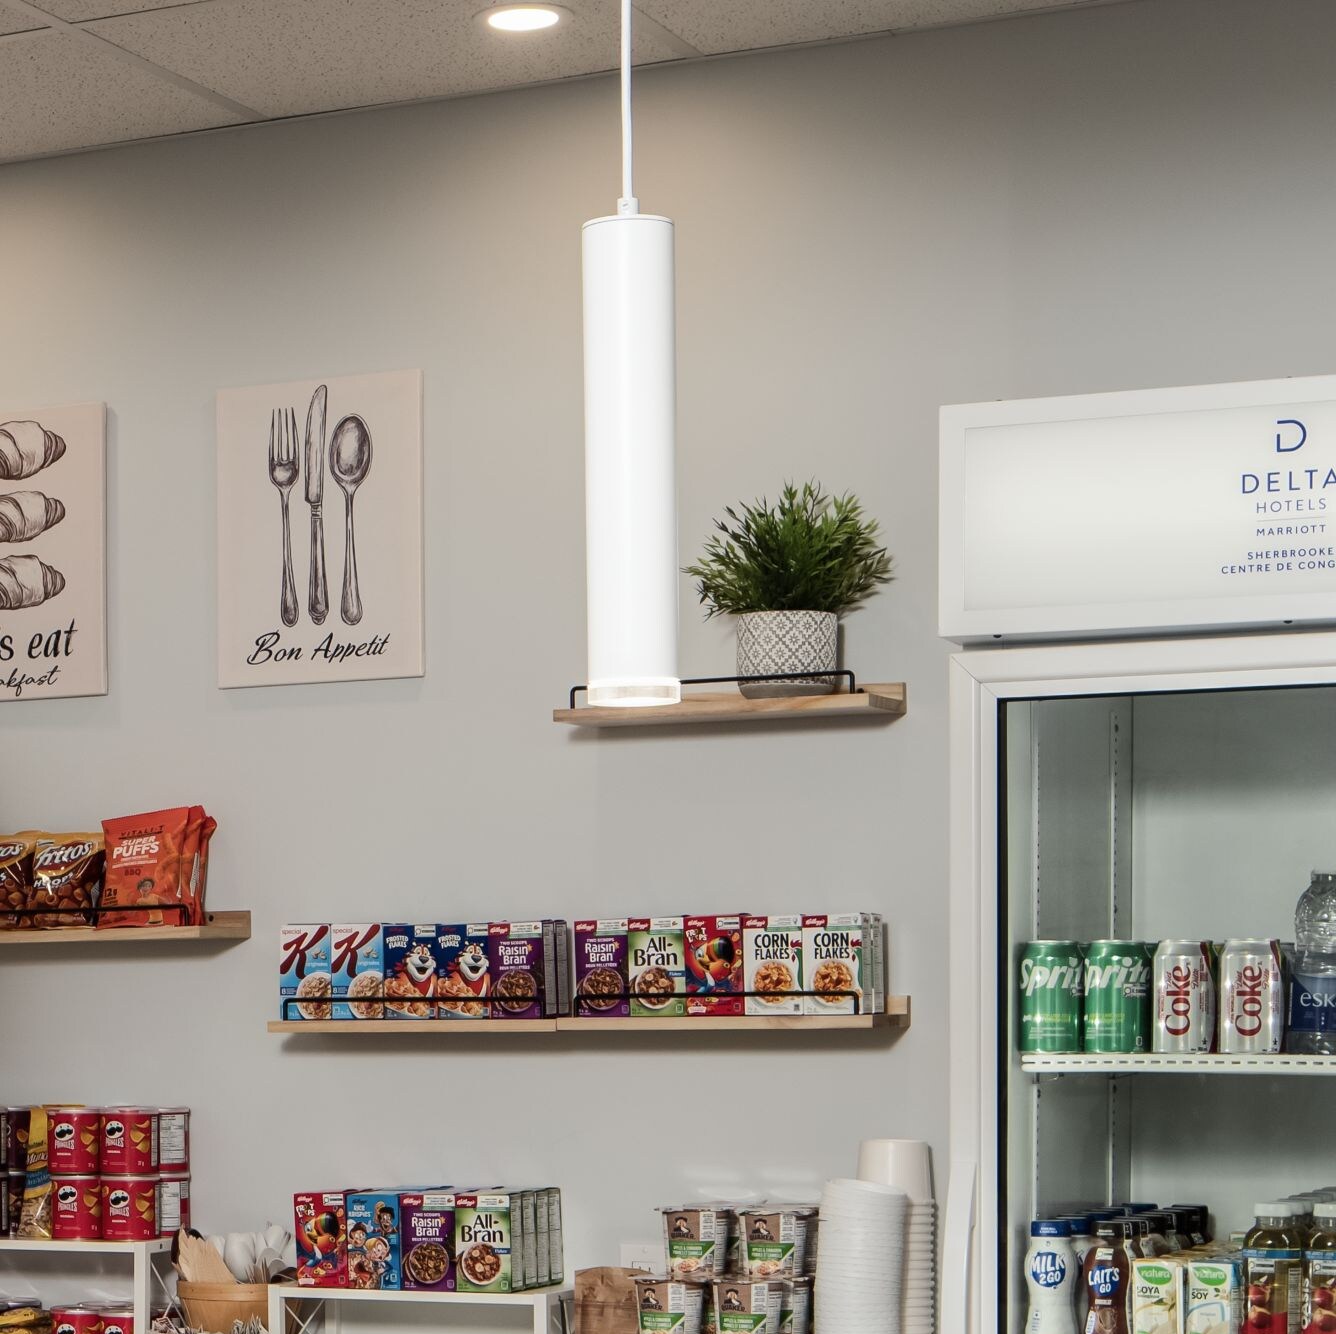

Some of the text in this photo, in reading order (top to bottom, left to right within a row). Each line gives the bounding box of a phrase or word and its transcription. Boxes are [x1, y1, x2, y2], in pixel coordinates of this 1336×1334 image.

[1242, 468, 1336, 494] DELTA
[1256, 498, 1327, 514] HOTELS
[1256, 524, 1326, 537] MARRIOTT
[1247, 547, 1335, 560] SHERBROOKE
[1221, 563, 1271, 575] CENTRE
[1276, 562, 1293, 572] DE
[28, 617, 79, 660] eat
[247, 629, 392, 666] Bon Appetit
[121, 836, 156, 847] SUPER
[34, 841, 93, 871] Fritos
[113, 841, 160, 859] PUFFS
[34, 872, 74, 888] HOPS
[754, 933, 789, 948] CORN
[813, 932, 849, 947] CORN
[280, 925, 329, 980] K
[331, 924, 381, 979] K
[499, 945, 529, 957] Raisin
[585, 943, 615, 954] Raisin
[755, 948, 790, 960] FLAKES
[814, 947, 850, 959] FLAKES
[503, 955, 526, 965] Bran
[589, 952, 613, 963] Bran
[634, 949, 678, 966] Bran
[1165, 965, 1191, 1036] Coke
[1235, 965, 1262, 1036] Coke
[1300, 992, 1336, 1007] esk
[411, 1217, 441, 1227] Raisin
[416, 1226, 439, 1237] Bran
[461, 1225, 503, 1243] Bran
[1031, 1253, 1065, 1272] MILK
[1040, 1271, 1061, 1284] 2GO
[1088, 1267, 1120, 1286] LAIT'S
[1141, 1268, 1170, 1278] natura
[1100, 1284, 1111, 1293] GO
[1191, 1291, 1208, 1300] SOY
